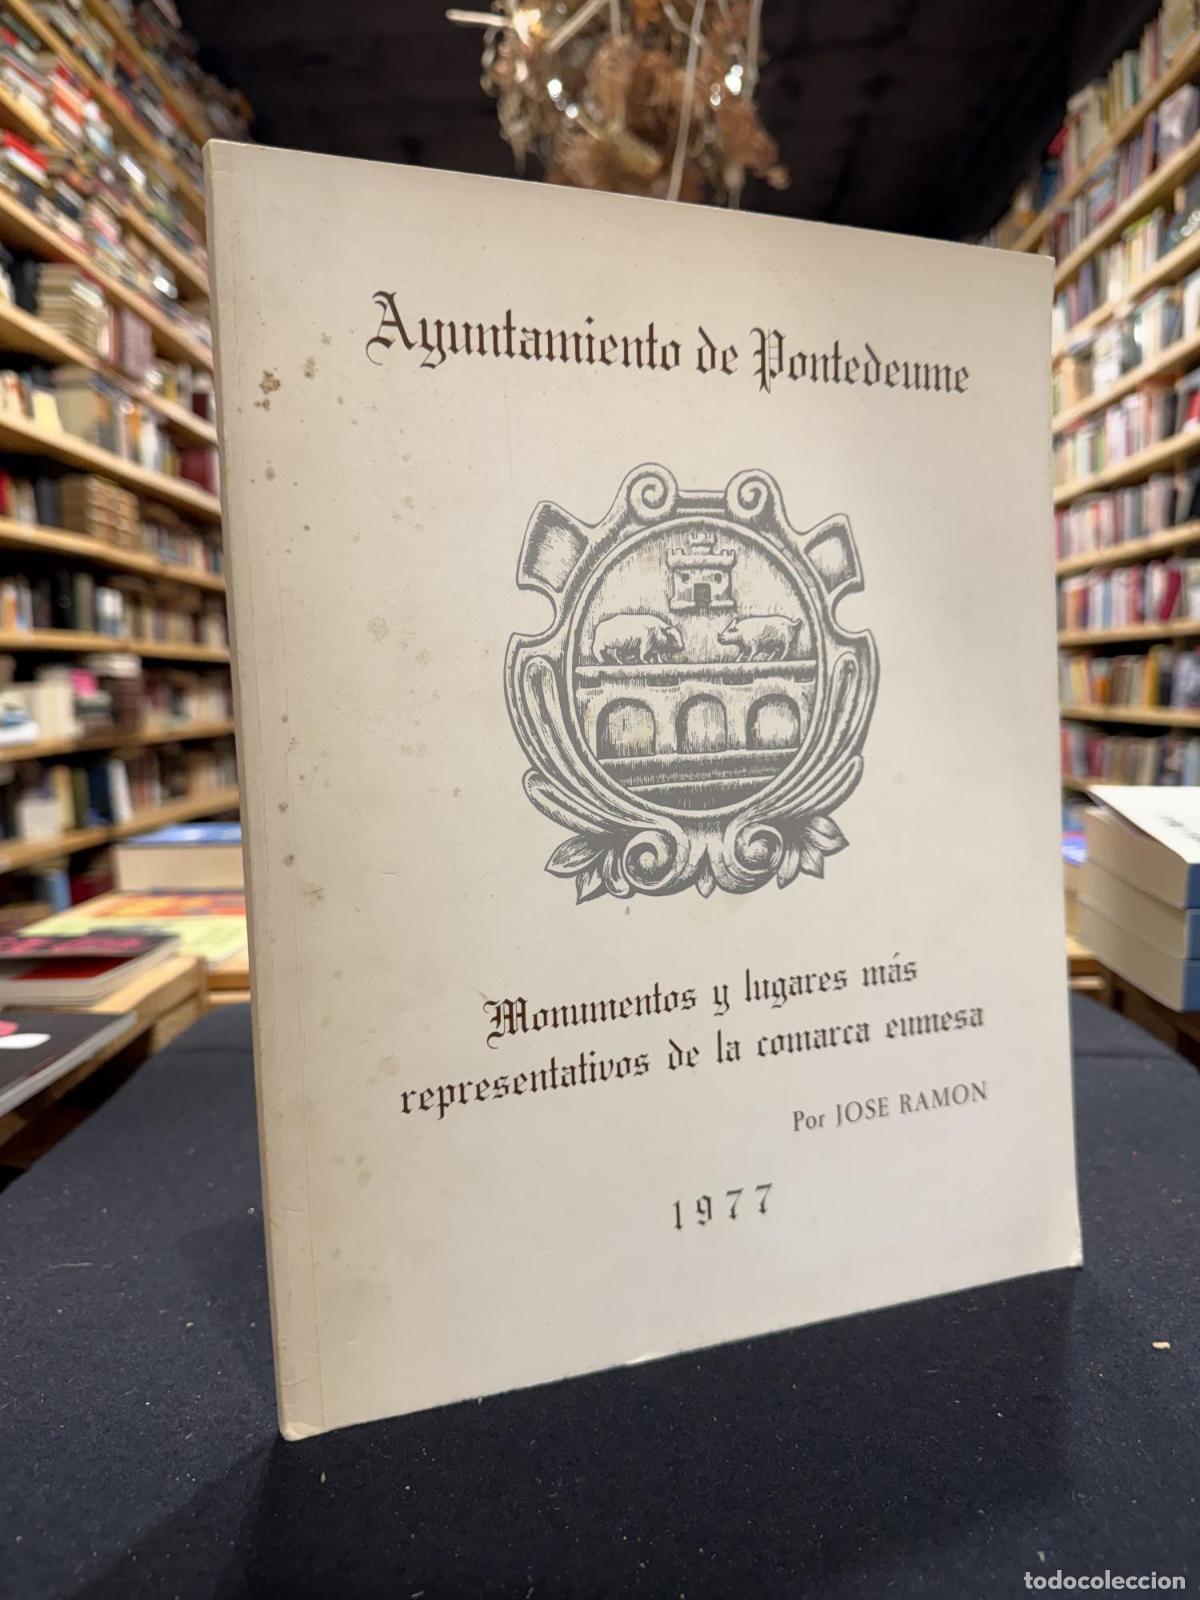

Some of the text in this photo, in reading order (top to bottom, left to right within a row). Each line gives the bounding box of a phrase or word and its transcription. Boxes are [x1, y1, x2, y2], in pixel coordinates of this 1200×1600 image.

[366, 291, 969, 394] Ayuntamiento de Pontedeume
[483, 952, 918, 1050] Monumentos y lugares más
[400, 1007, 985, 1120] representativos de la comarca eumesa
[793, 1080, 988, 1132] Por JOSE RAMON
[672, 1182, 773, 1230] 1977
